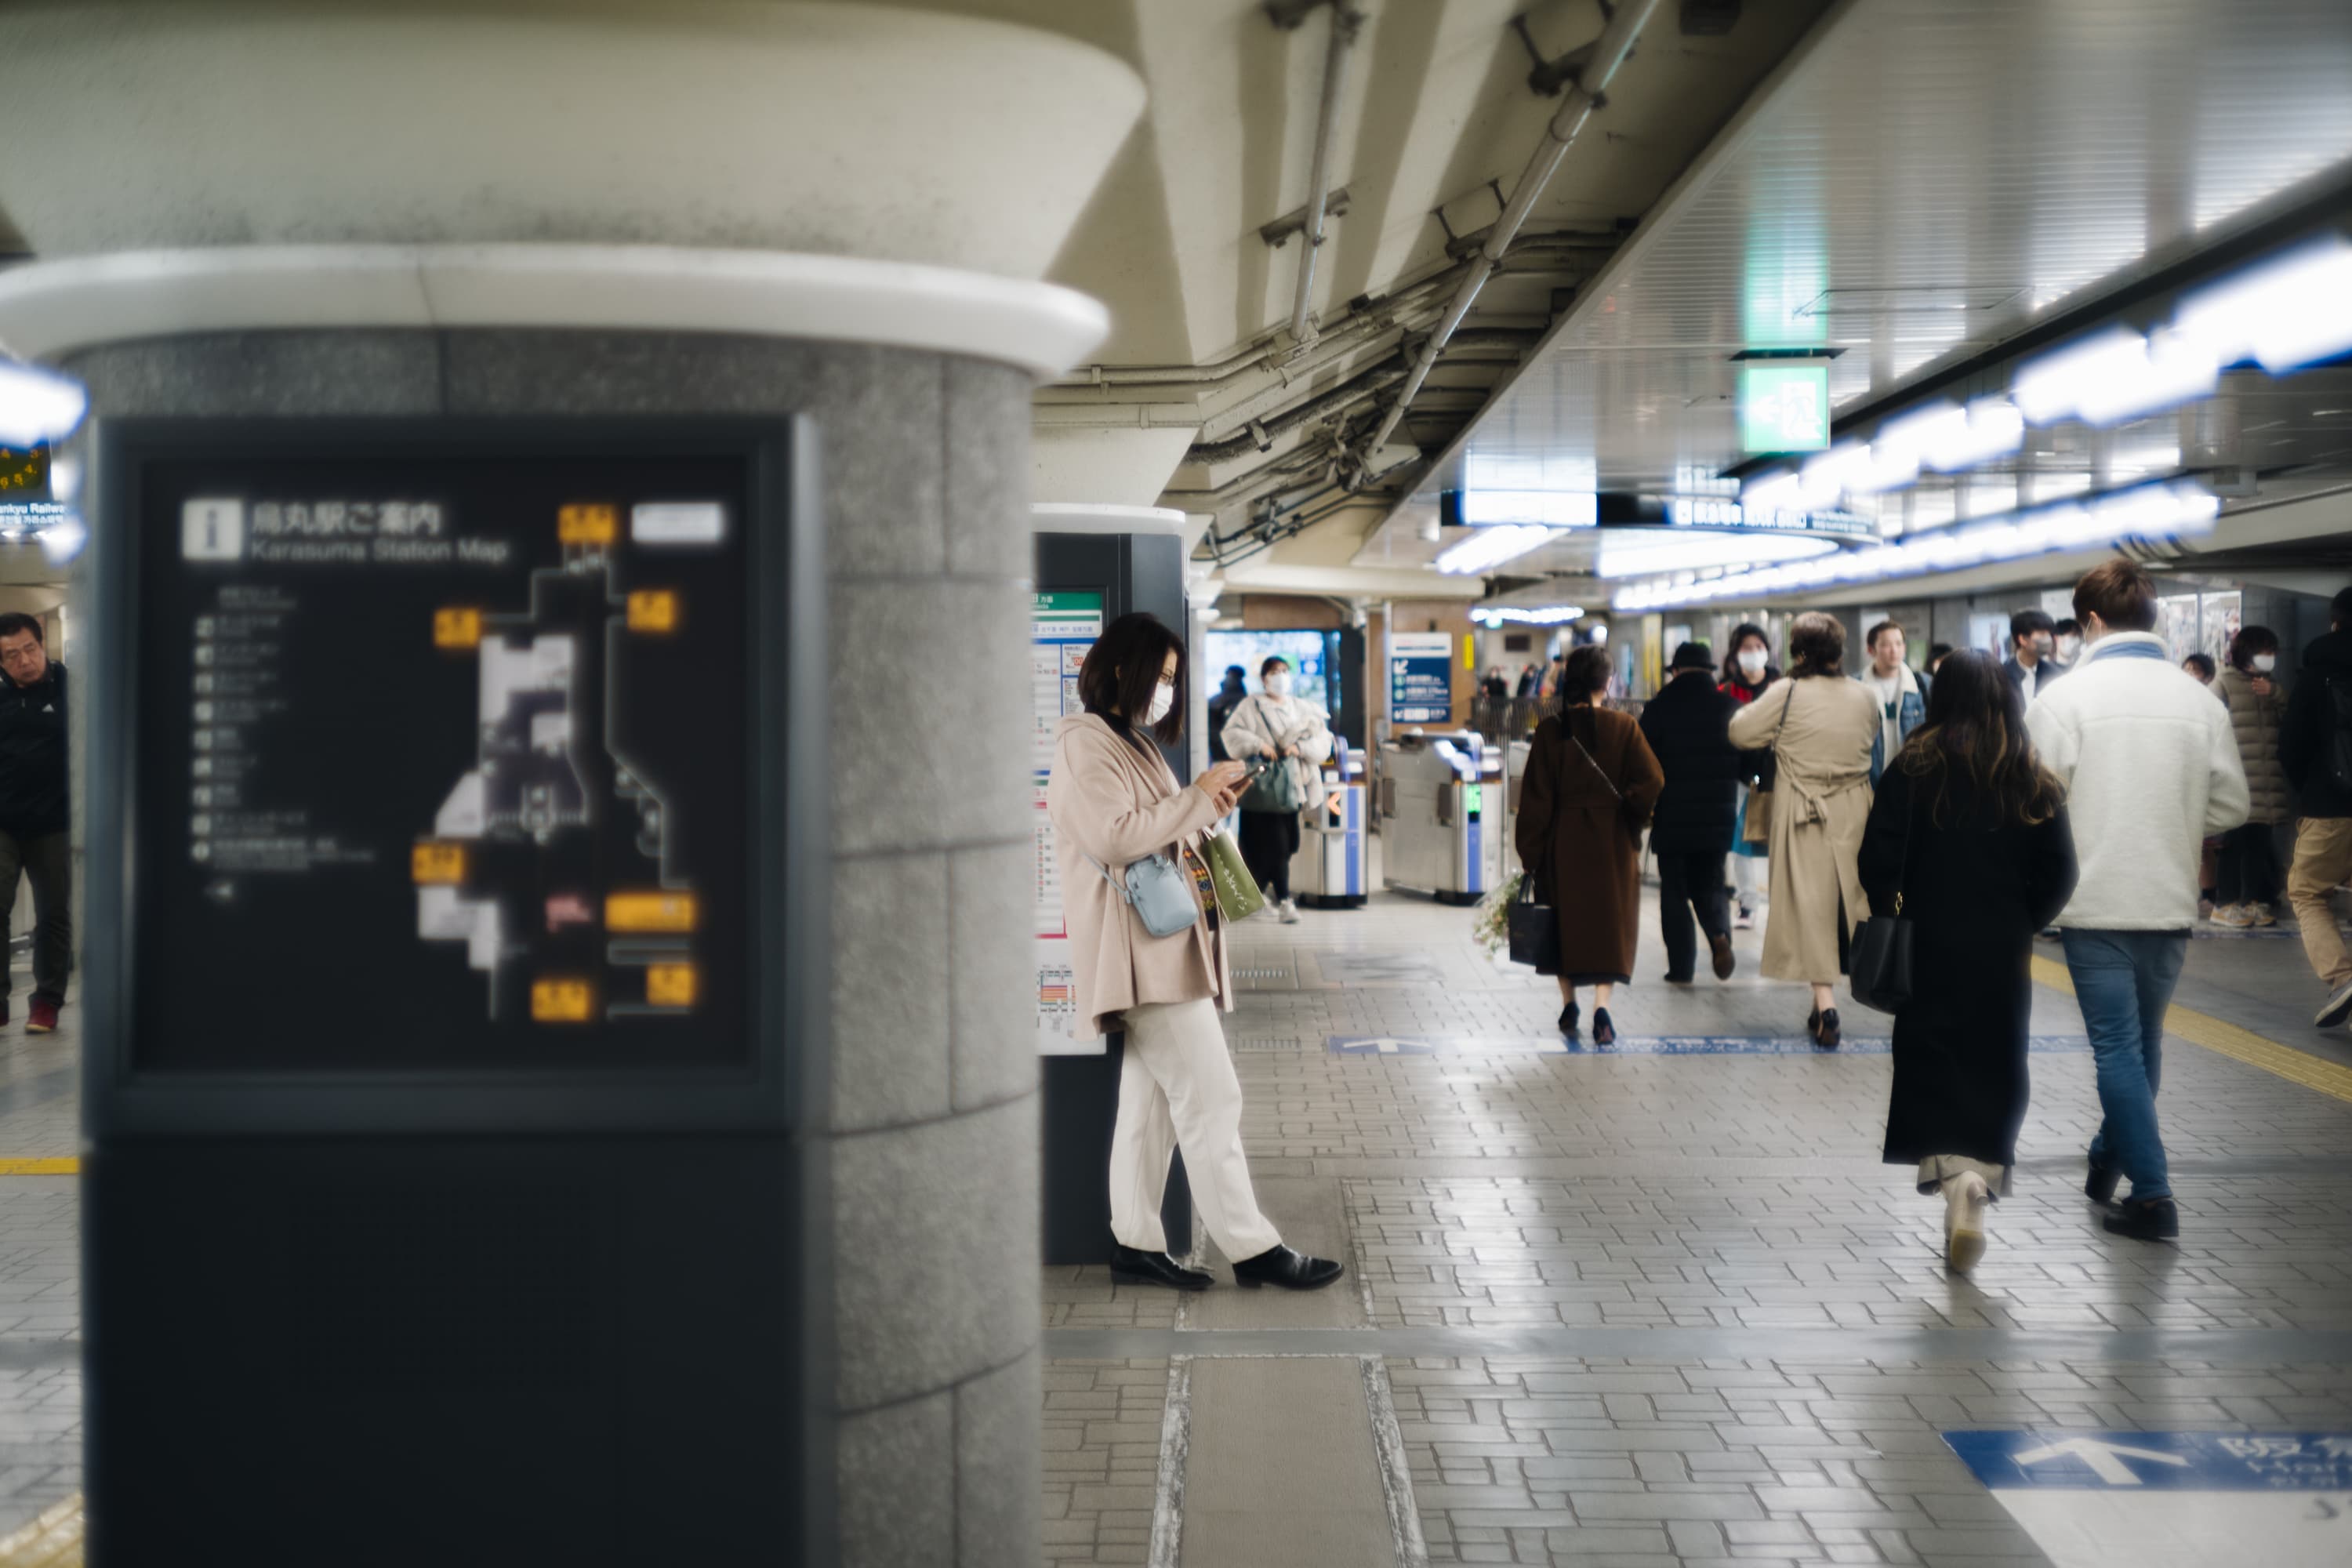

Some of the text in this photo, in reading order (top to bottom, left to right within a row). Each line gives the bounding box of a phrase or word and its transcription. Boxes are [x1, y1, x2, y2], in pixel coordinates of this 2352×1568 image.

[251, 538, 508, 564] Karasuma Station Map
